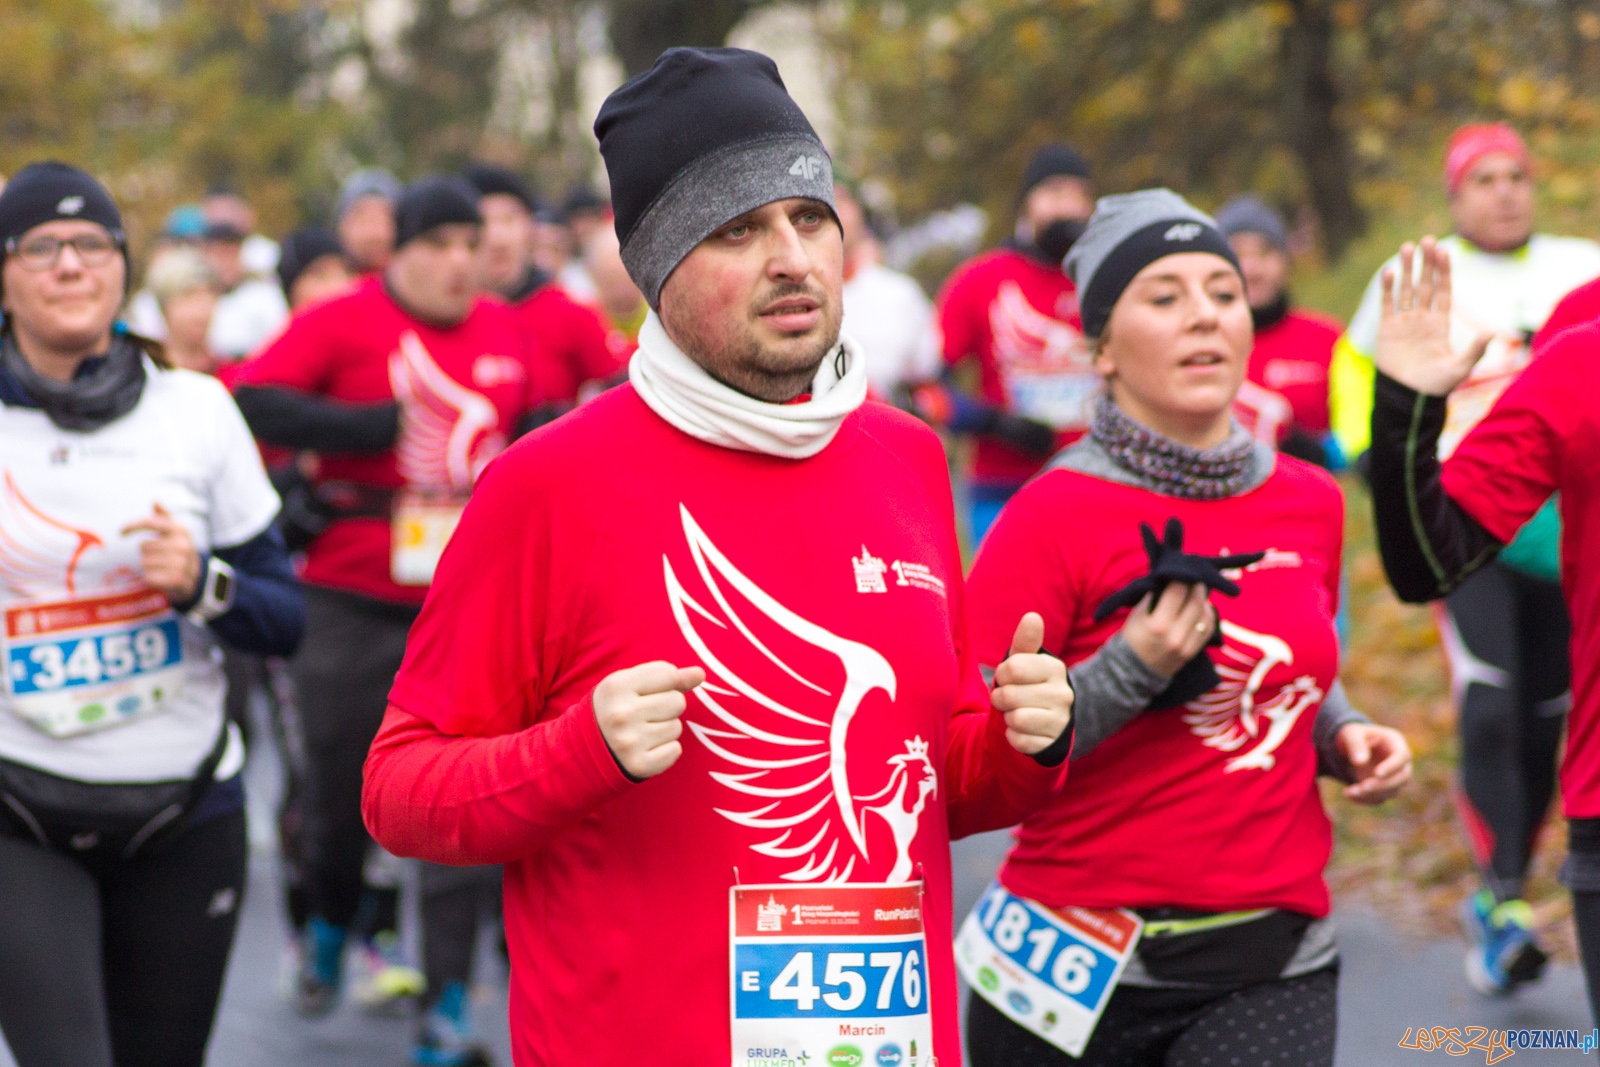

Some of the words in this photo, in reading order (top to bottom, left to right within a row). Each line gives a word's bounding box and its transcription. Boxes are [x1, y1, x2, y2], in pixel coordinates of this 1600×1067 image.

[29, 626, 169, 689] 3459
[982, 887, 1098, 995] 1816
[742, 971, 760, 992] E
[769, 949, 921, 1011] 4576
[747, 1048, 787, 1058] GRUPA
[839, 1024, 885, 1036] Marcin
